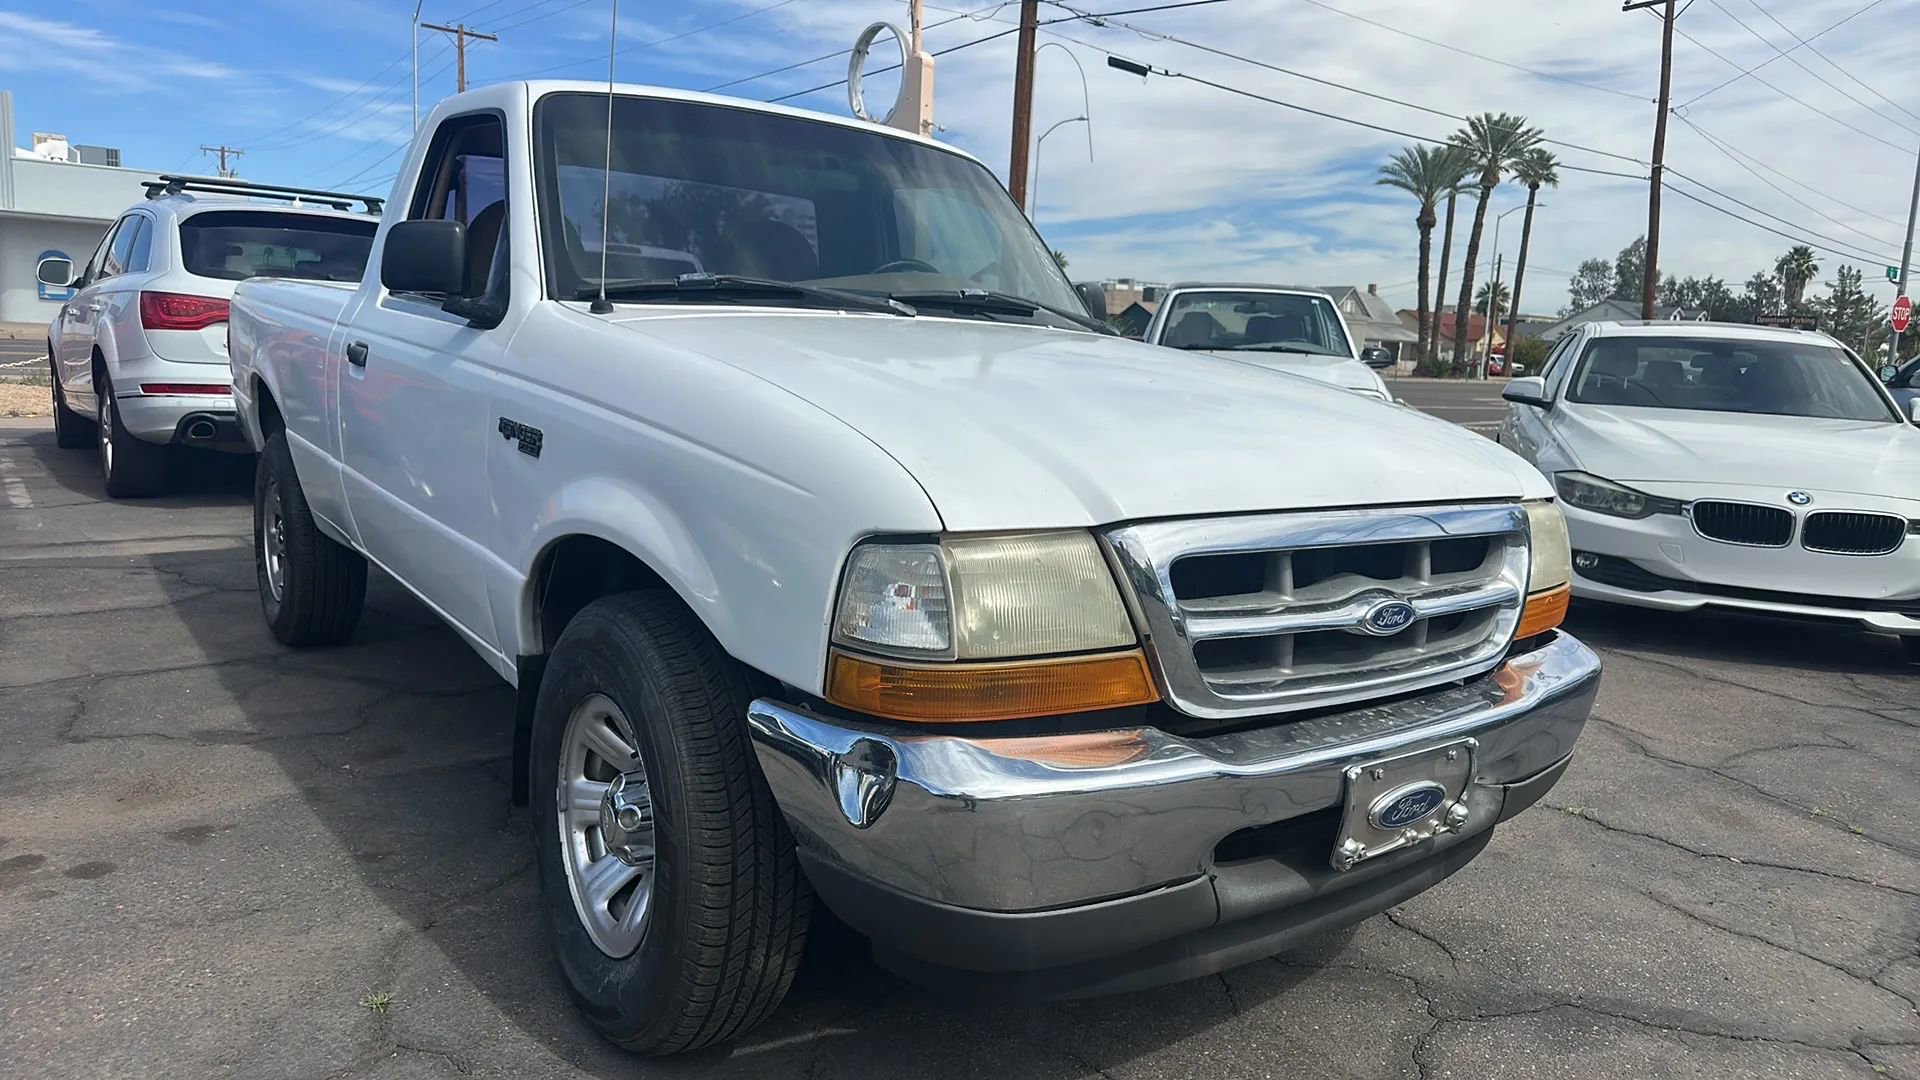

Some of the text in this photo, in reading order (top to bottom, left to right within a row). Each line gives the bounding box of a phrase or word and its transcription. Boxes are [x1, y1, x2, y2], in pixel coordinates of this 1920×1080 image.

[1791, 316, 1816, 326] Parking
[1893, 307, 1910, 320] STOP
[1377, 607, 1405, 625] Ford
[1391, 793, 1431, 820] Ford
